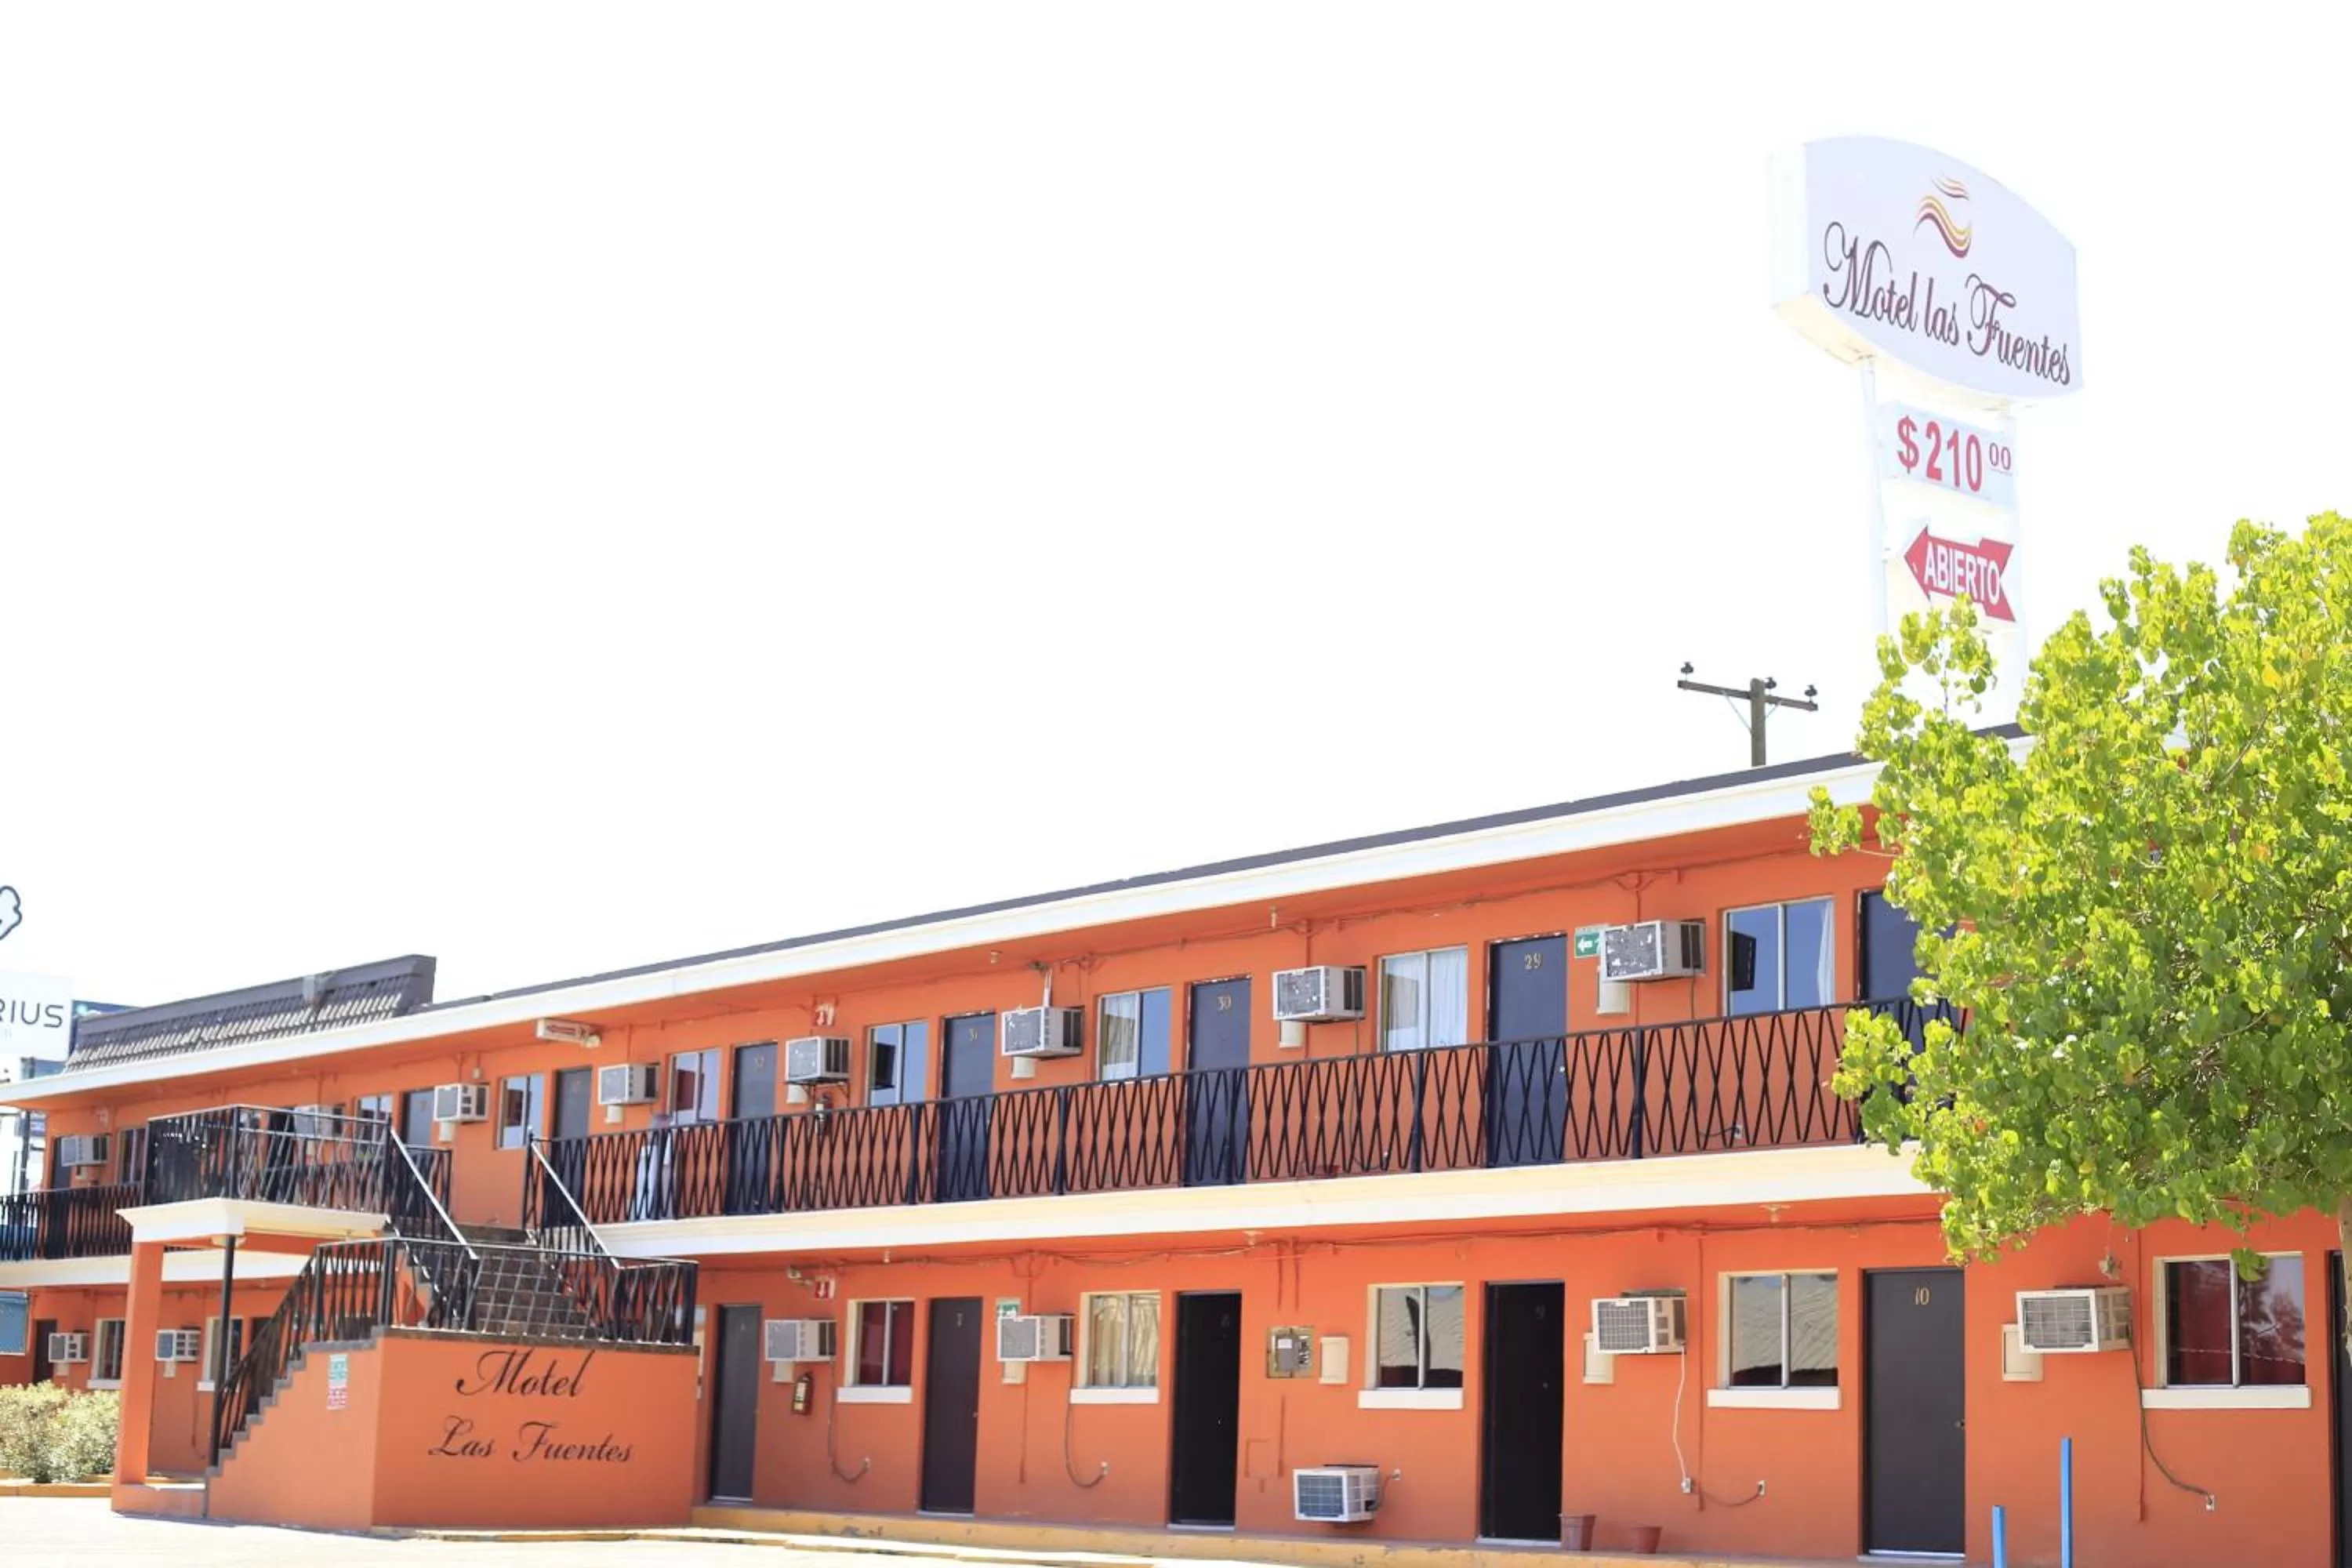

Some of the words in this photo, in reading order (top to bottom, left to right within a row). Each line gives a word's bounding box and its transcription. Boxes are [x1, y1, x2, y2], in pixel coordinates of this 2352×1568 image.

[1824, 221, 1918, 332] Motel
[1925, 276, 1959, 346] las
[1965, 274, 2071, 385] Fuentes
[1897, 416, 1982, 492] $210
[1924, 540, 2000, 605] ABIERTO
[1524, 953, 1542, 970] 29
[1217, 995, 1232, 1011] 30
[1915, 1286, 1929, 1305] 10
[456, 1348, 595, 1398] Motel
[427, 1414, 495, 1457] Las
[512, 1421, 633, 1462] Fuentes
